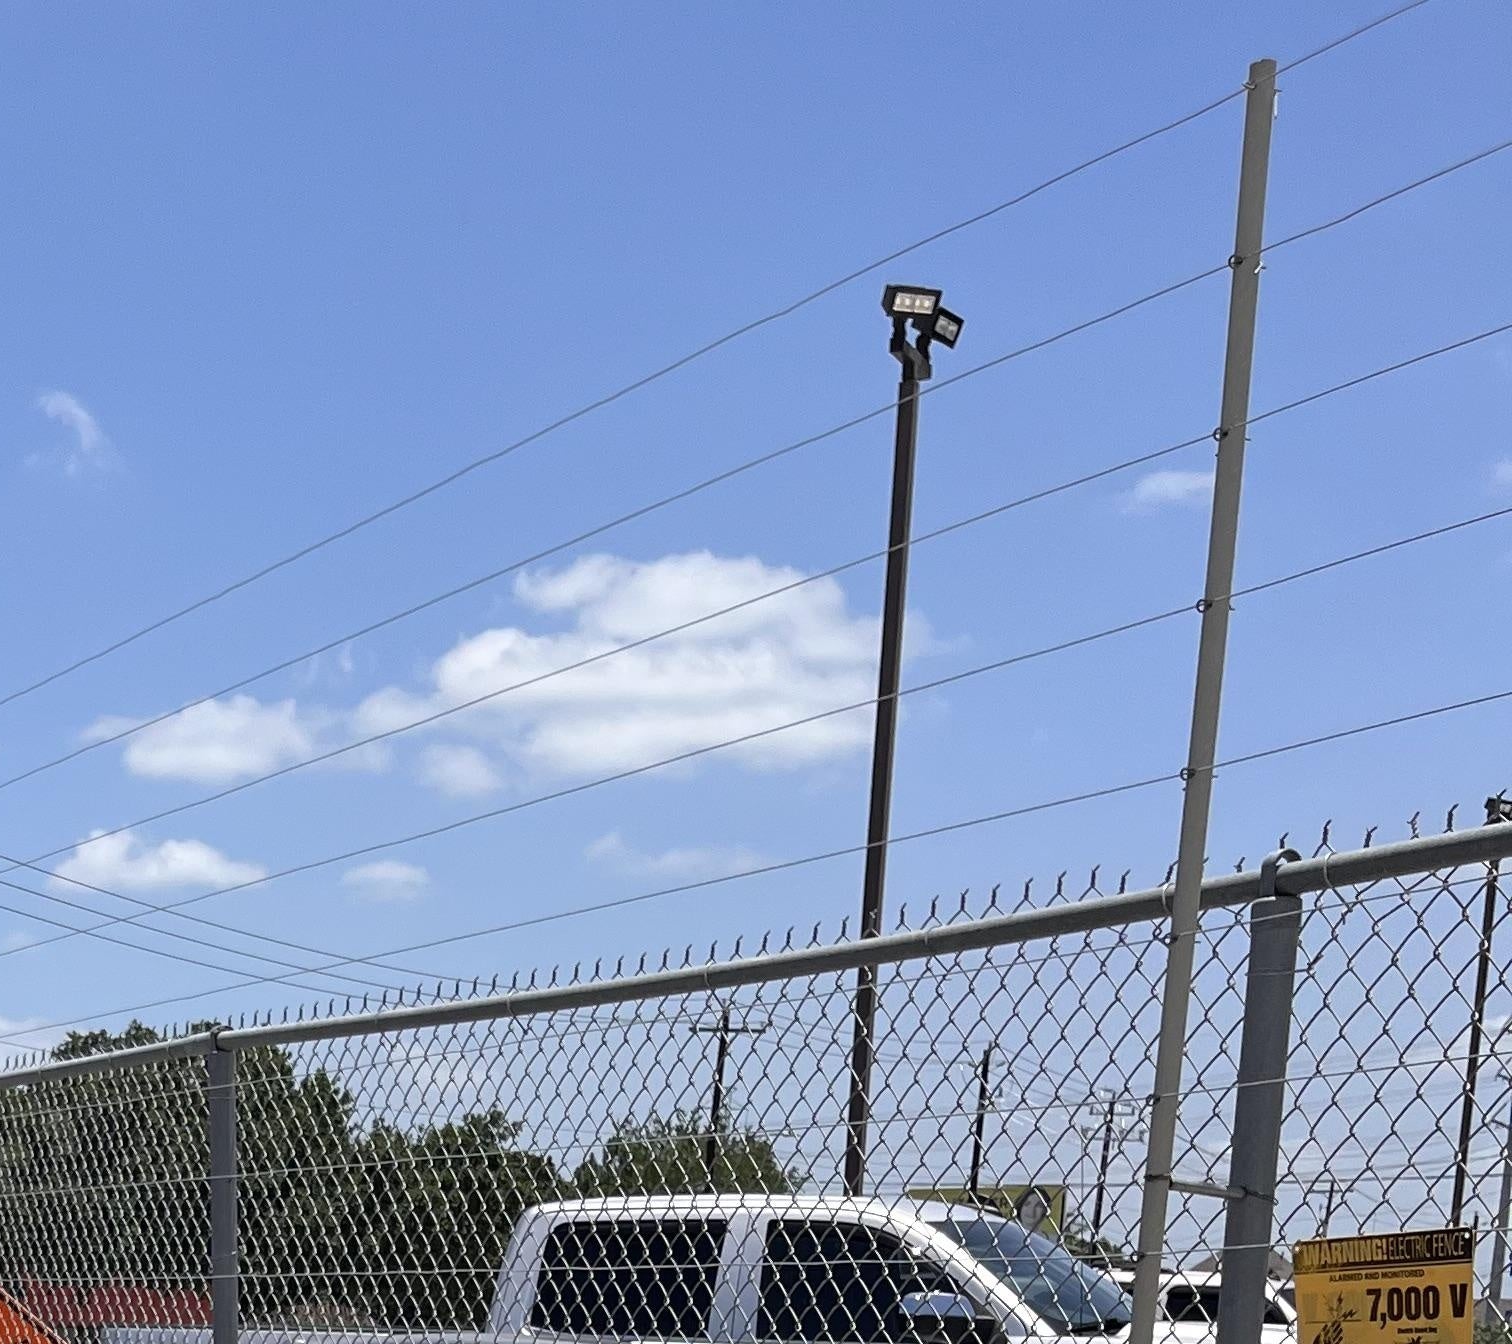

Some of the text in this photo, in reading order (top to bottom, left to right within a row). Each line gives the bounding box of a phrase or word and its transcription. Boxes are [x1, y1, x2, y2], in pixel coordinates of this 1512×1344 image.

[1300, 1232, 1465, 1266] WARNING! ELECTRIC FENCE
[1329, 1271, 1363, 1283] ALARMED
[1380, 1269, 1425, 1280] MONITORED
[1366, 1283, 1468, 1329] 7,000 V
